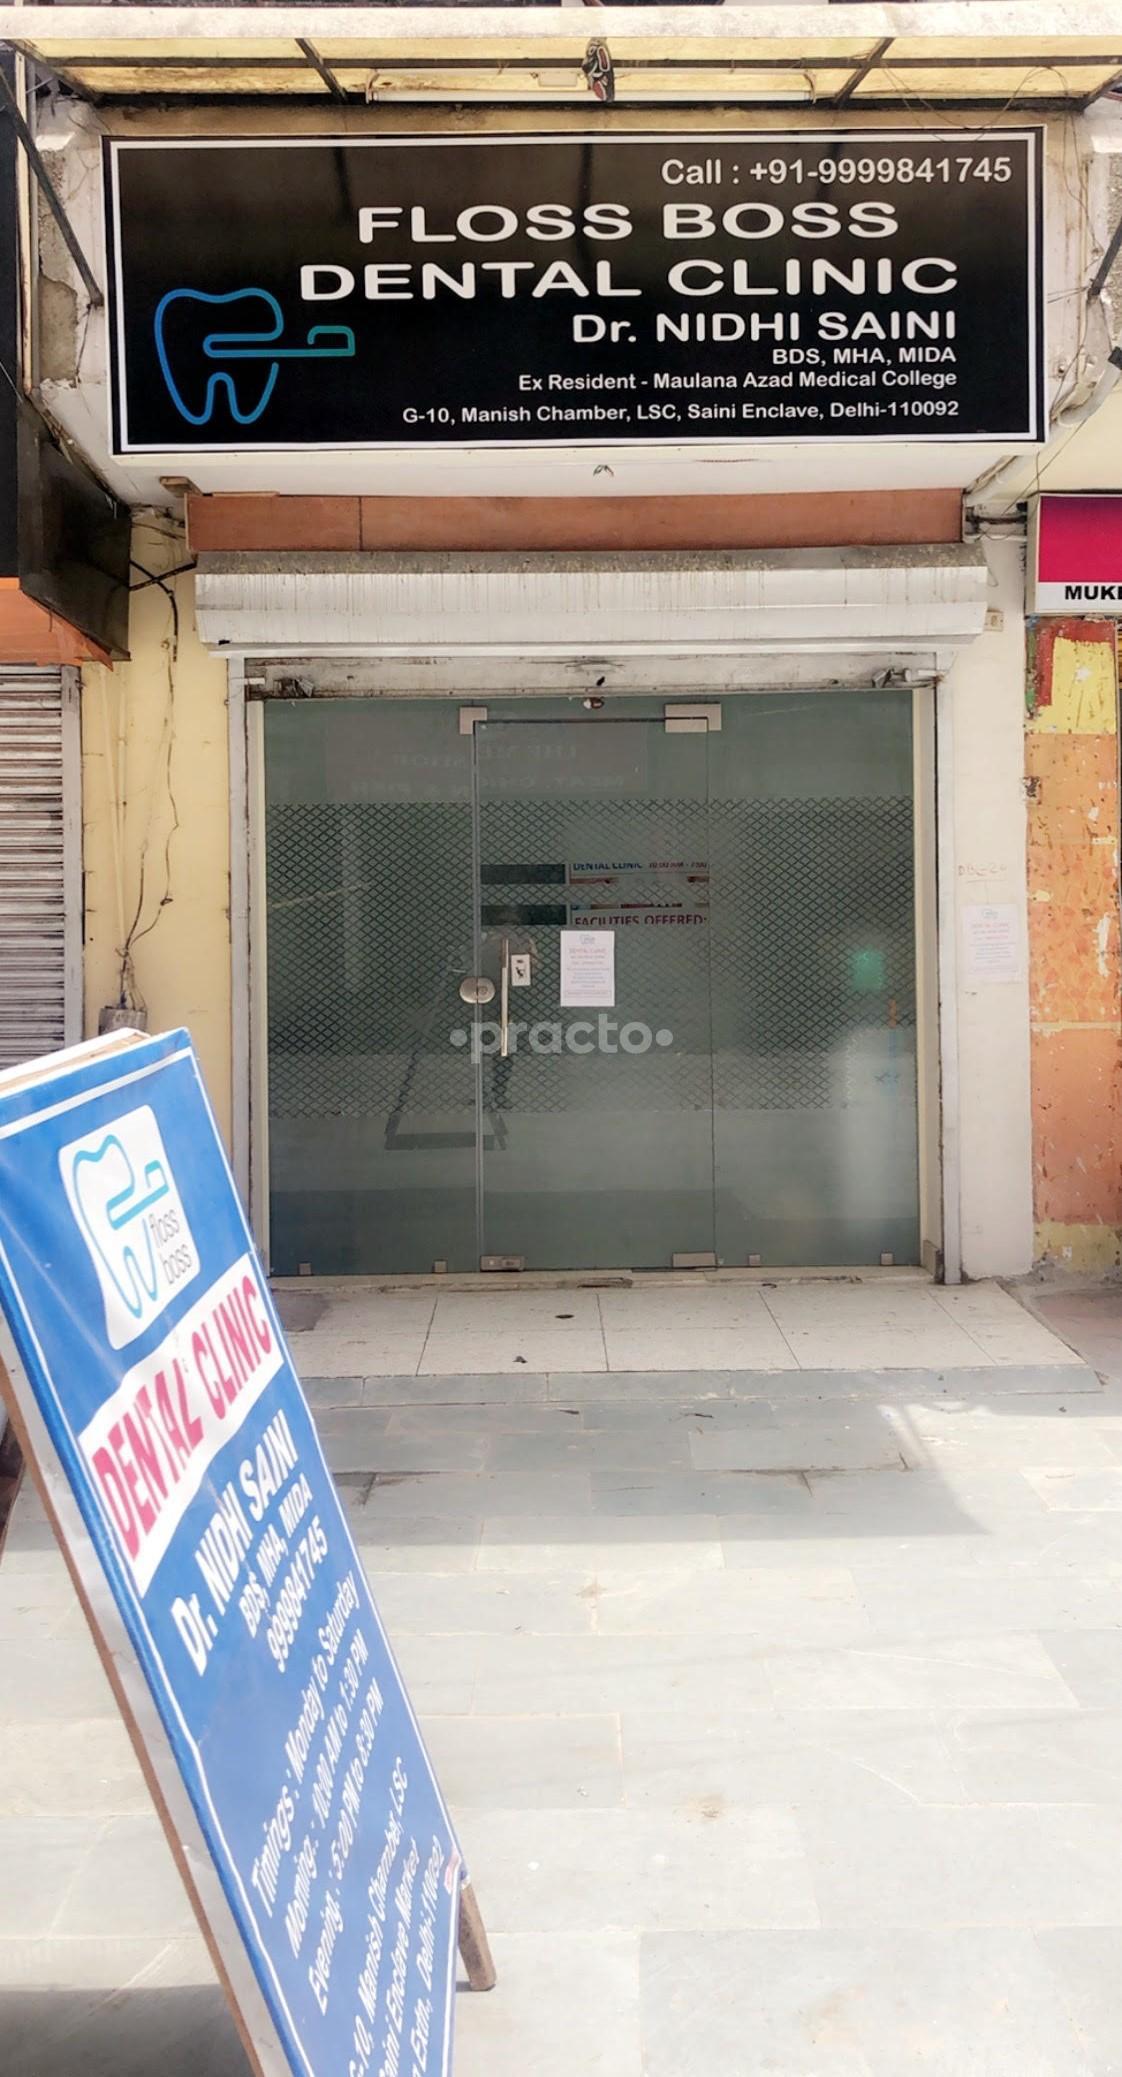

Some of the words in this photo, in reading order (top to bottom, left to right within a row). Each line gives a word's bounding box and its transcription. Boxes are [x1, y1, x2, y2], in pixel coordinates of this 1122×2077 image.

[661, 158, 722, 185] Call
[732, 164, 740, 185] :
[750, 156, 1012, 184] +91-9999841745
[358, 203, 633, 243] FLOSS
[663, 202, 898, 240] BOSS
[300, 259, 642, 300] DENTAL
[667, 257, 957, 297] CLINIC
[573, 313, 637, 344] Dr.
[656, 312, 799, 343] NIDHI
[818, 310, 956, 341] SAINI
[773, 348, 826, 367] BDS,
[834, 347, 892, 367] MHA,
[899, 346, 956, 364] MIDA
[519, 375, 543, 391] Ex
[548, 373, 636, 390] Resident
[654, 372, 737, 389] Maulana
[743, 371, 793, 388] Azad
[799, 370, 875, 387] Medical
[882, 369, 957, 390] College
[402, 408, 456, 426] G-10,
[462, 406, 531, 424] Manish
[537, 404, 631, 423] Chamber,
[637, 404, 681, 422] LSC,
[687, 403, 736, 420] Saini
[742, 402, 823, 421] Enclave,
[830, 401, 959, 419] Delhi-110092
[1065, 585, 1122, 600] MUK
[149, 1209, 179, 1248] floss
[160, 1244, 192, 1285] boss
[92, 1358, 203, 1561] DENTAL
[192, 1275, 272, 1420] CLINIC
[170, 1592, 219, 1678] Dr.
[195, 1481, 253, 1616] NIDHI
[240, 1408, 298, 1521] SAINI
[238, 1575, 271, 1638] BDS,
[256, 1523, 289, 1588] MHA,
[278, 1473, 313, 1538] MIDA
[266, 1515, 328, 1673] 9999841745
[318, 1570, 360, 1665] Saturday
[312, 1654, 328, 1691] to
[350, 1628, 369, 1676] PM
[339, 1658, 359, 1712] 1:30
[366, 1677, 384, 1727] PM
[285, 1676, 325, 1784] Monday
[333, 1703, 348, 1737] to
[324, 1715, 342, 1774] AM
[350, 1757, 364, 1792] to
[342, 1771, 361, 1828] PM
